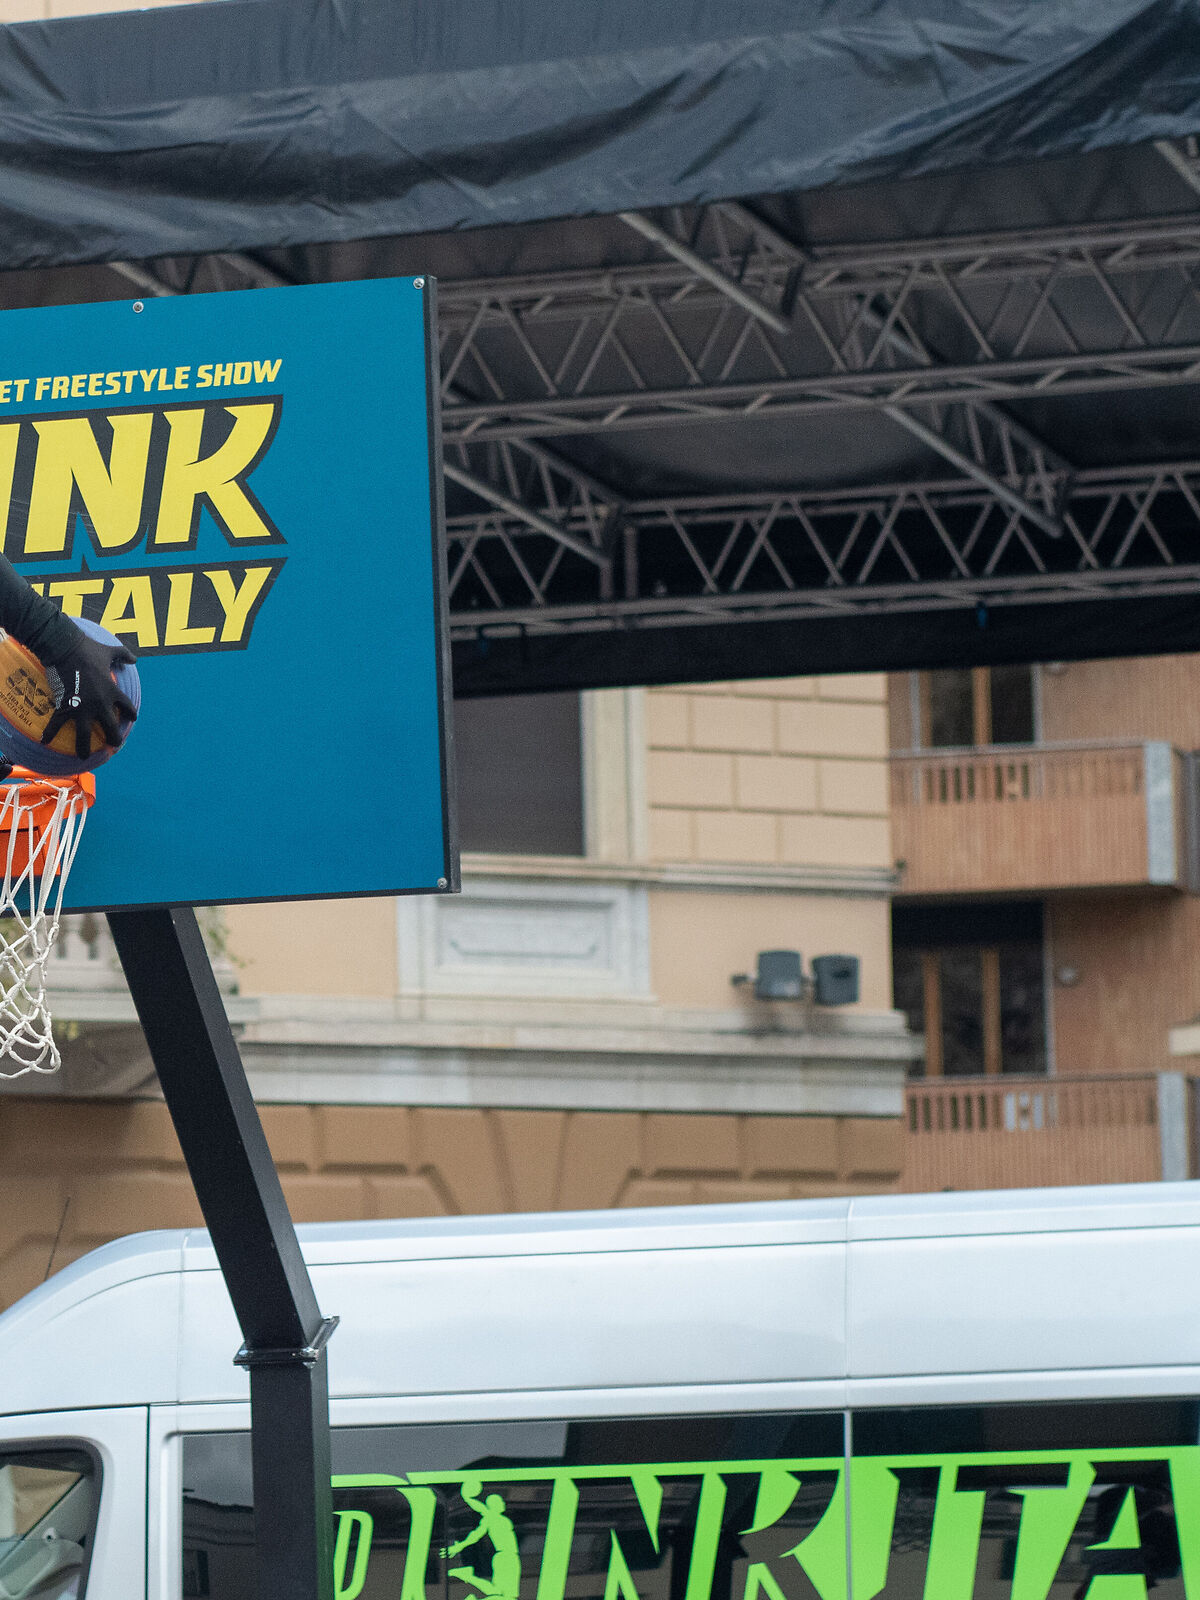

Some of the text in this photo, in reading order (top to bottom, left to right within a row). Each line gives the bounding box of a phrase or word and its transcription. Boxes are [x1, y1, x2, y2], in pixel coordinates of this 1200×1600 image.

[34, 365, 191, 401] FREESTYLE
[196, 359, 283, 388] SHOW
[30, 566, 273, 648] TALY
